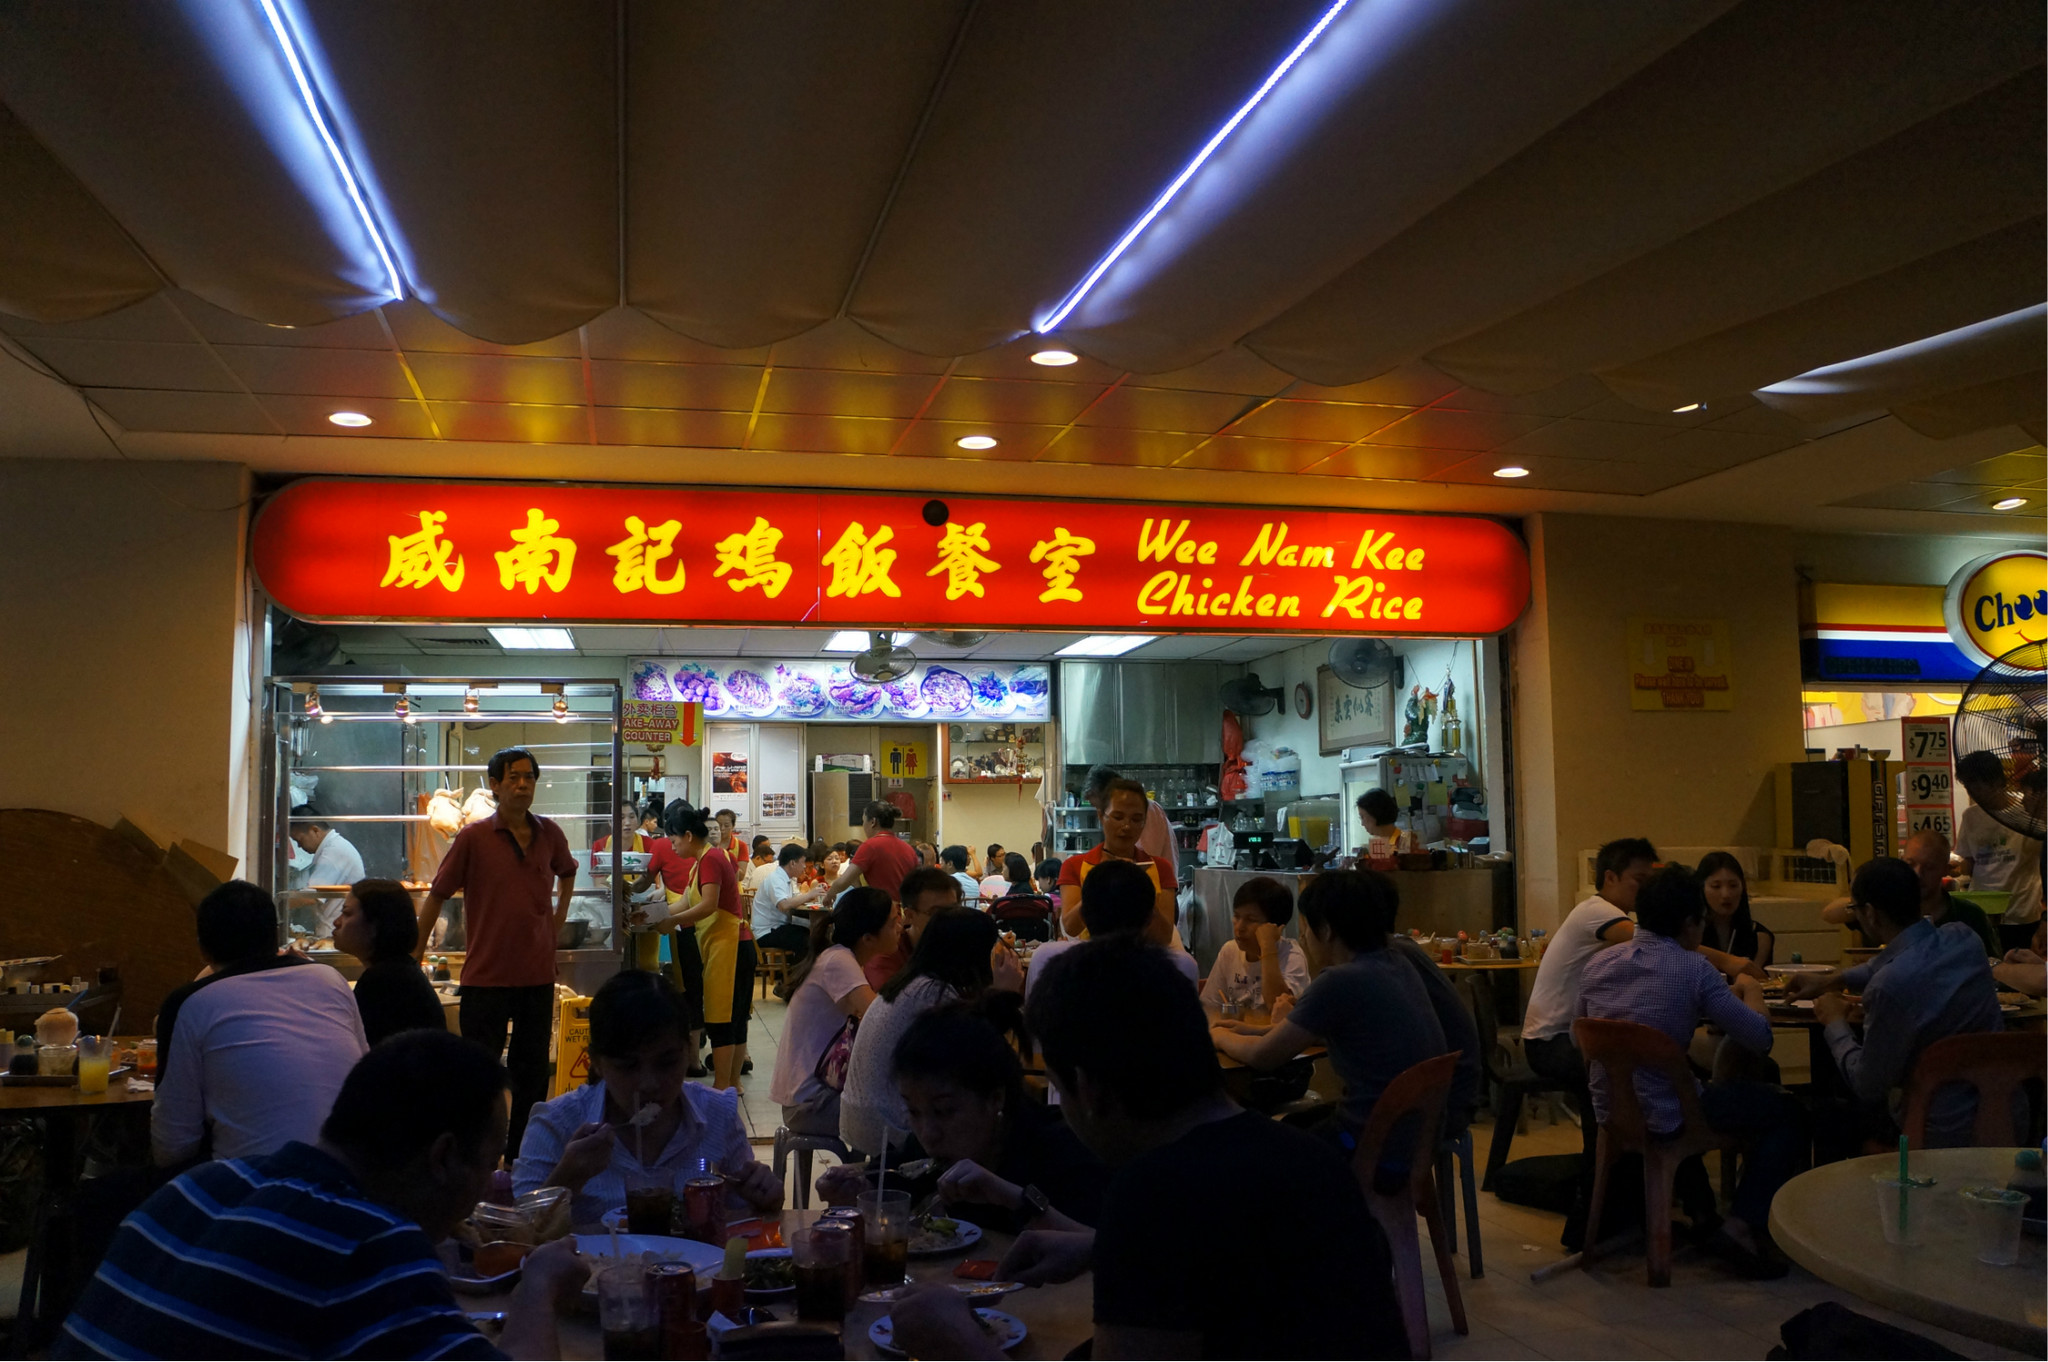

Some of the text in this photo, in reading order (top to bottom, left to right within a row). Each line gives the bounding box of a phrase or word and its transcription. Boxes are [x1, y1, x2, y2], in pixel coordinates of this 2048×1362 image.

[1137, 518, 1425, 570] Wee Nam Kee
[1136, 570, 1423, 620] Chicken Rice
[623, 703, 678, 718] 外卖柜台
[624, 731, 672, 742] COUNTER
